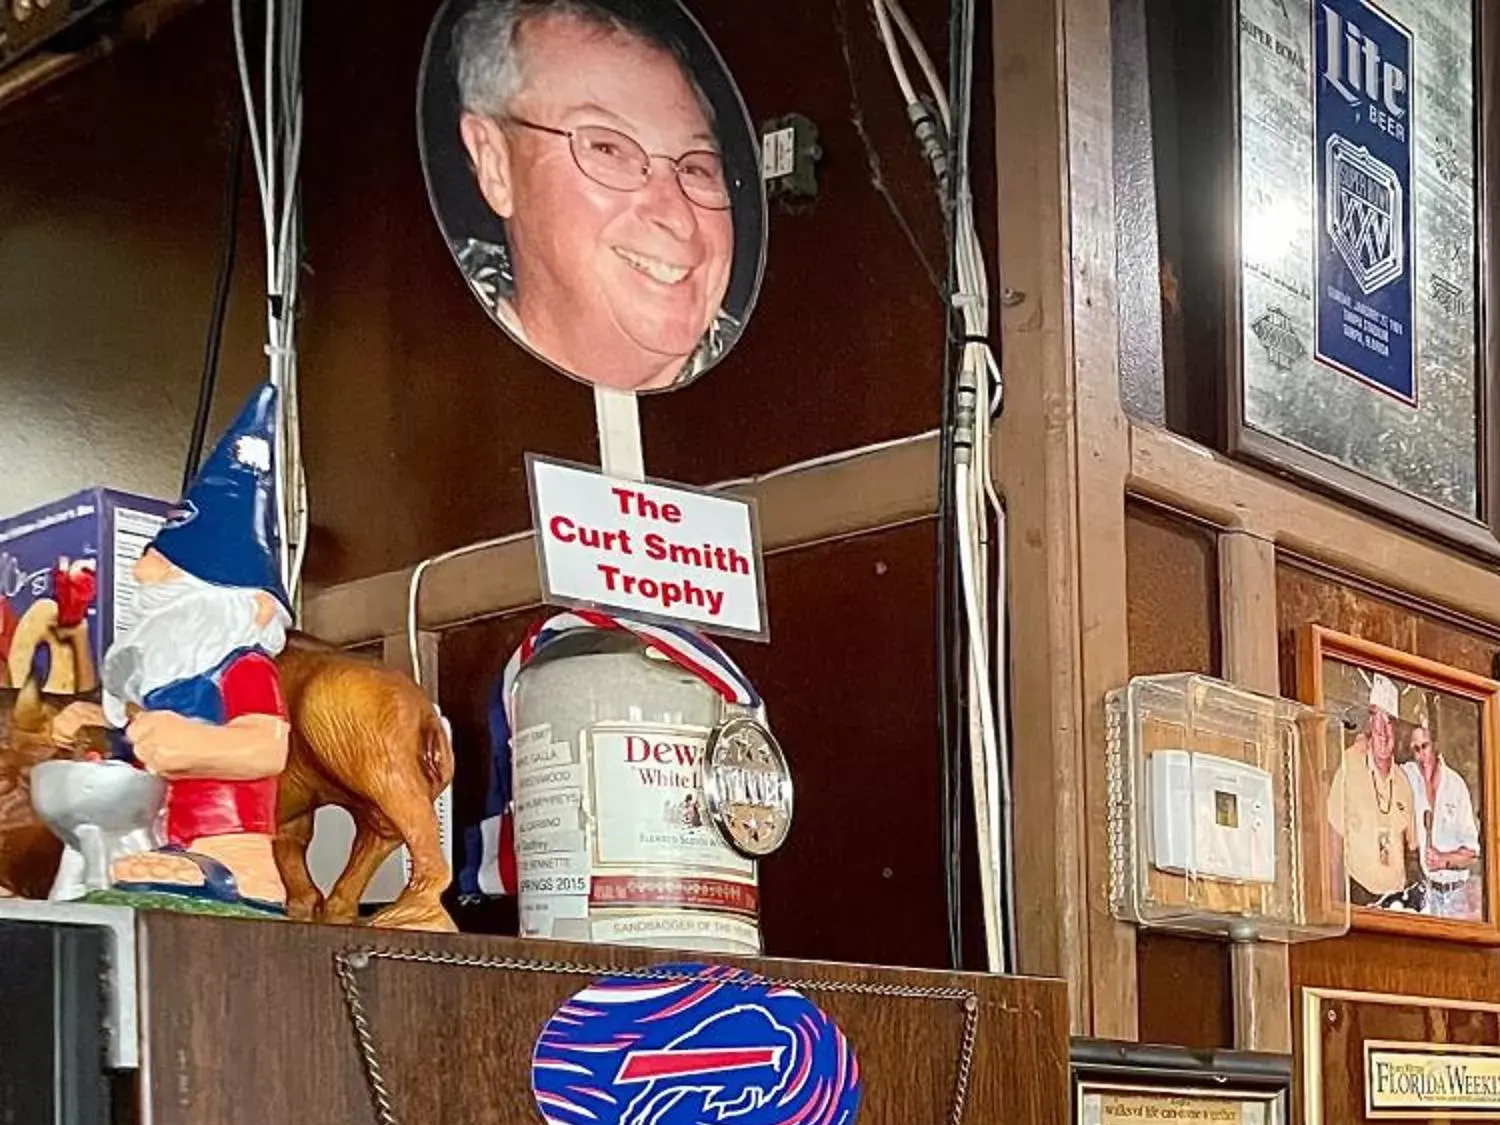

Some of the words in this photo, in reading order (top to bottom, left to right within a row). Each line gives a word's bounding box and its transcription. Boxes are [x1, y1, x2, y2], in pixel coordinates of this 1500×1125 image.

[1322, 3, 1406, 120] Lite
[1369, 104, 1405, 142] BEER
[612, 487, 683, 524] The
[549, 515, 633, 555] Curt
[645, 534, 750, 575] Smith
[598, 565, 725, 615] Trophy
[624, 736, 704, 766] Dew
[640, 769, 689, 788] White
[556, 877, 586, 891] 2015
[1376, 1061, 1446, 1101] FLORIDA
